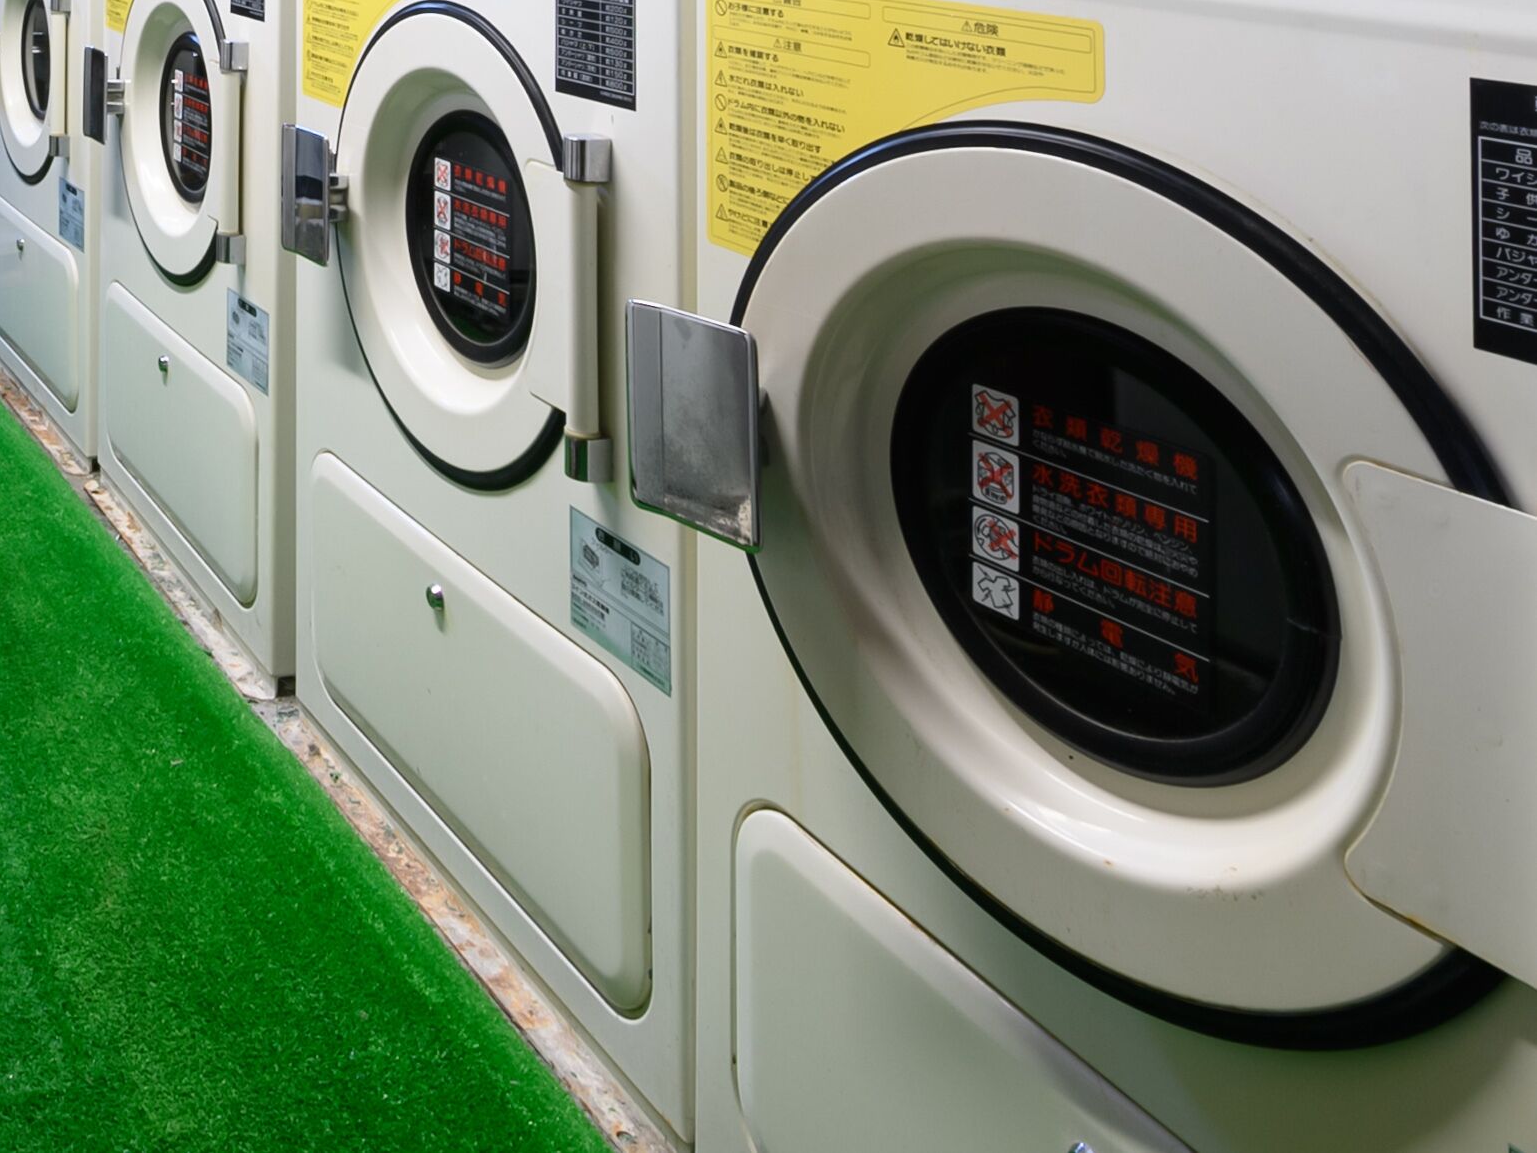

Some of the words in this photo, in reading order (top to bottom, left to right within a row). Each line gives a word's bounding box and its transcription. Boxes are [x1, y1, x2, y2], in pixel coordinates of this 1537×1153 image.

[905, 31, 1007, 58] 乾燥してはいけない衣類
[973, 21, 999, 38] 危険
[1515, 148, 1534, 166] 品
[1032, 404, 1198, 481] 衣類乾燥機
[1031, 462, 1198, 544] 水洗衣類専用
[1033, 530, 1198, 620] ドラム回転注意
[1031, 588, 1199, 684] 静電気
